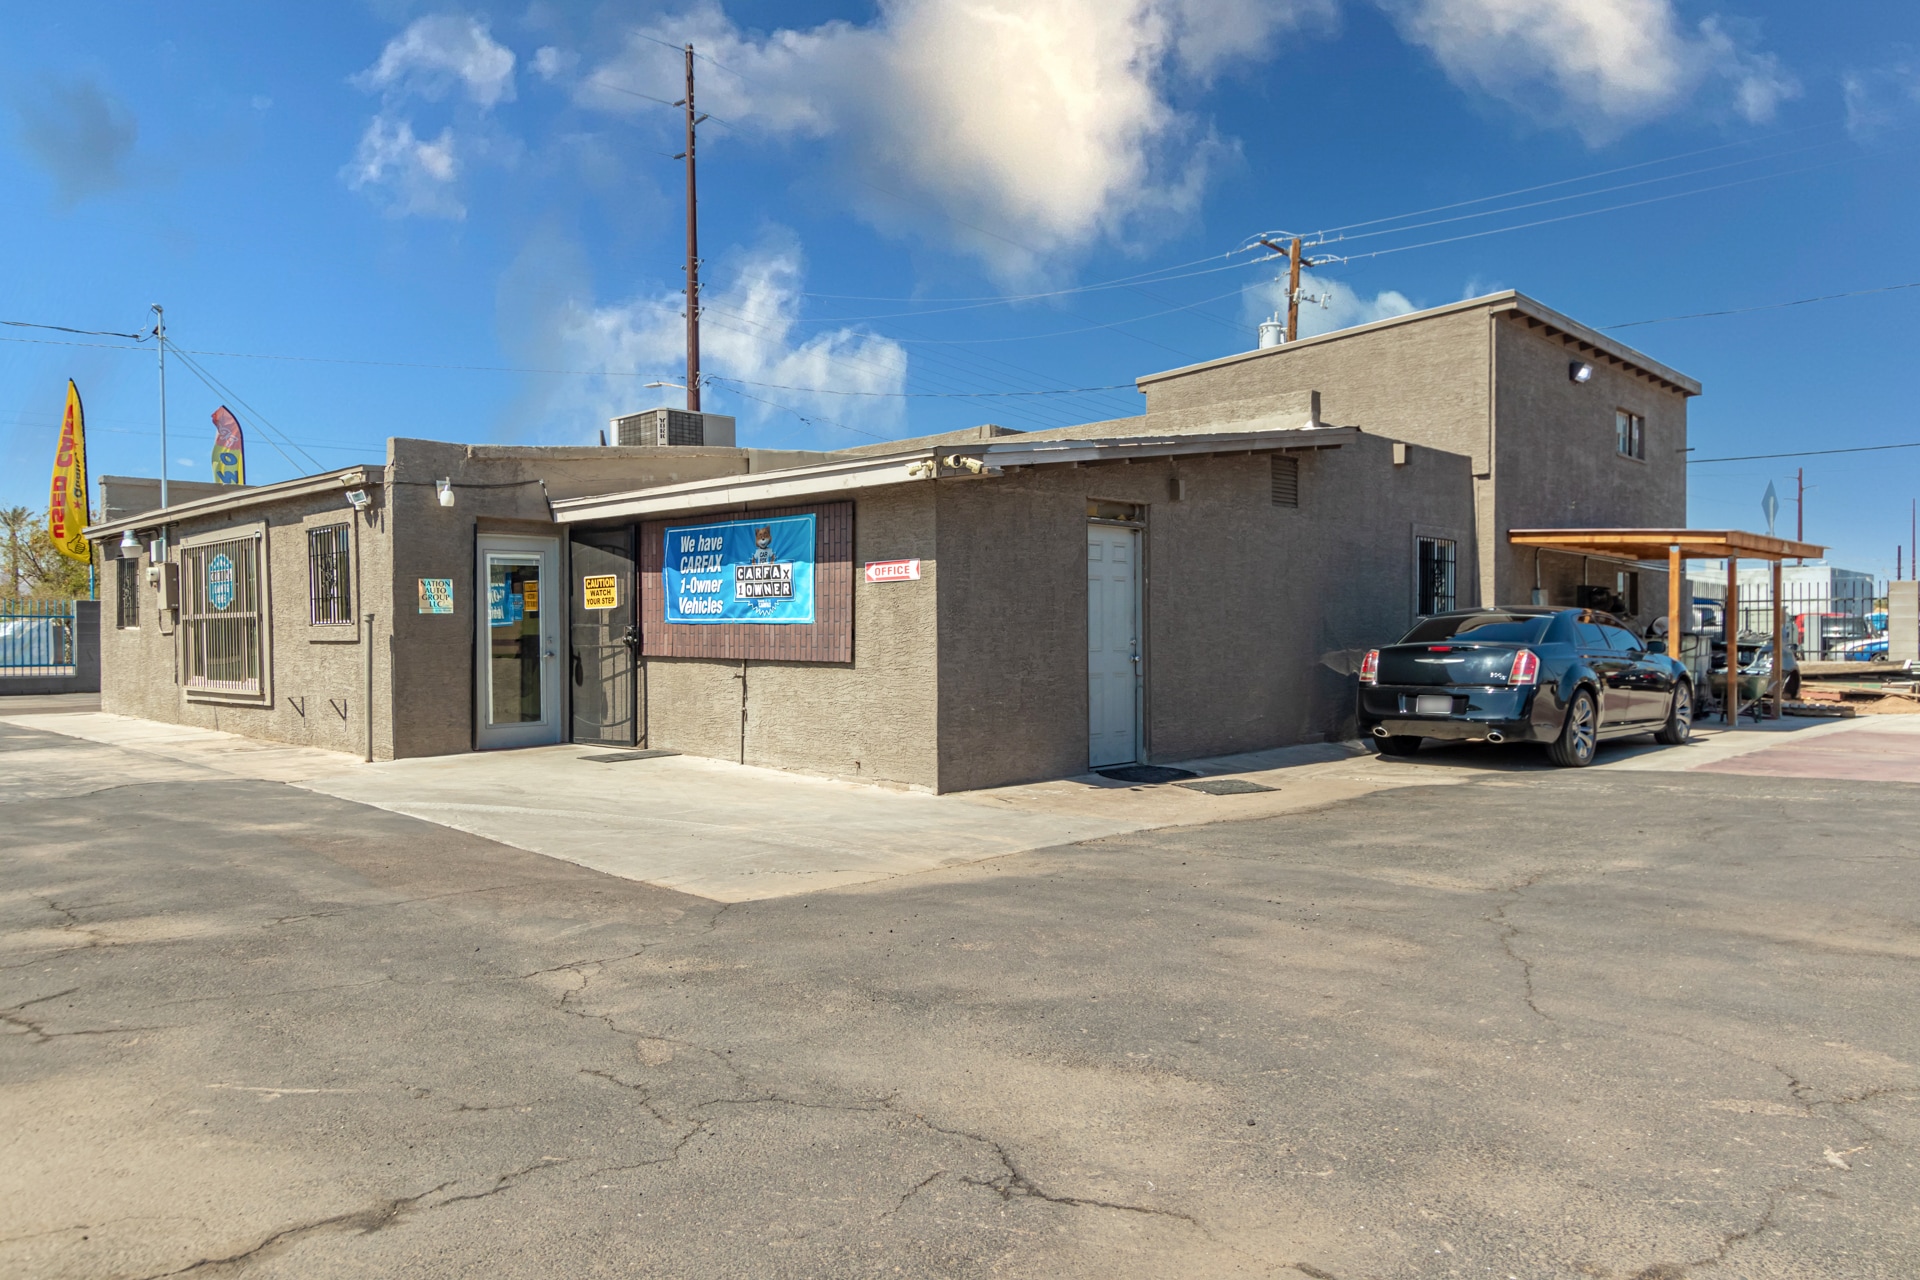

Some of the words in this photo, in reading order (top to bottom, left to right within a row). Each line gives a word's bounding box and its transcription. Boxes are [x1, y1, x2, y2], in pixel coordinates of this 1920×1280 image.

[680, 535, 695, 553] We
[697, 534, 723, 552] have
[680, 554, 723, 575] CARFAX
[874, 565, 910, 576] OFFICE
[737, 565, 790, 580] CARFAX
[586, 577, 615, 589] CAUTION
[680, 576, 723, 594] 1-Owner
[421, 593, 450, 601] GROUP
[590, 589, 611, 597] WATCH
[601, 596, 615, 605] STEP
[678, 596, 724, 615] Vehicles
